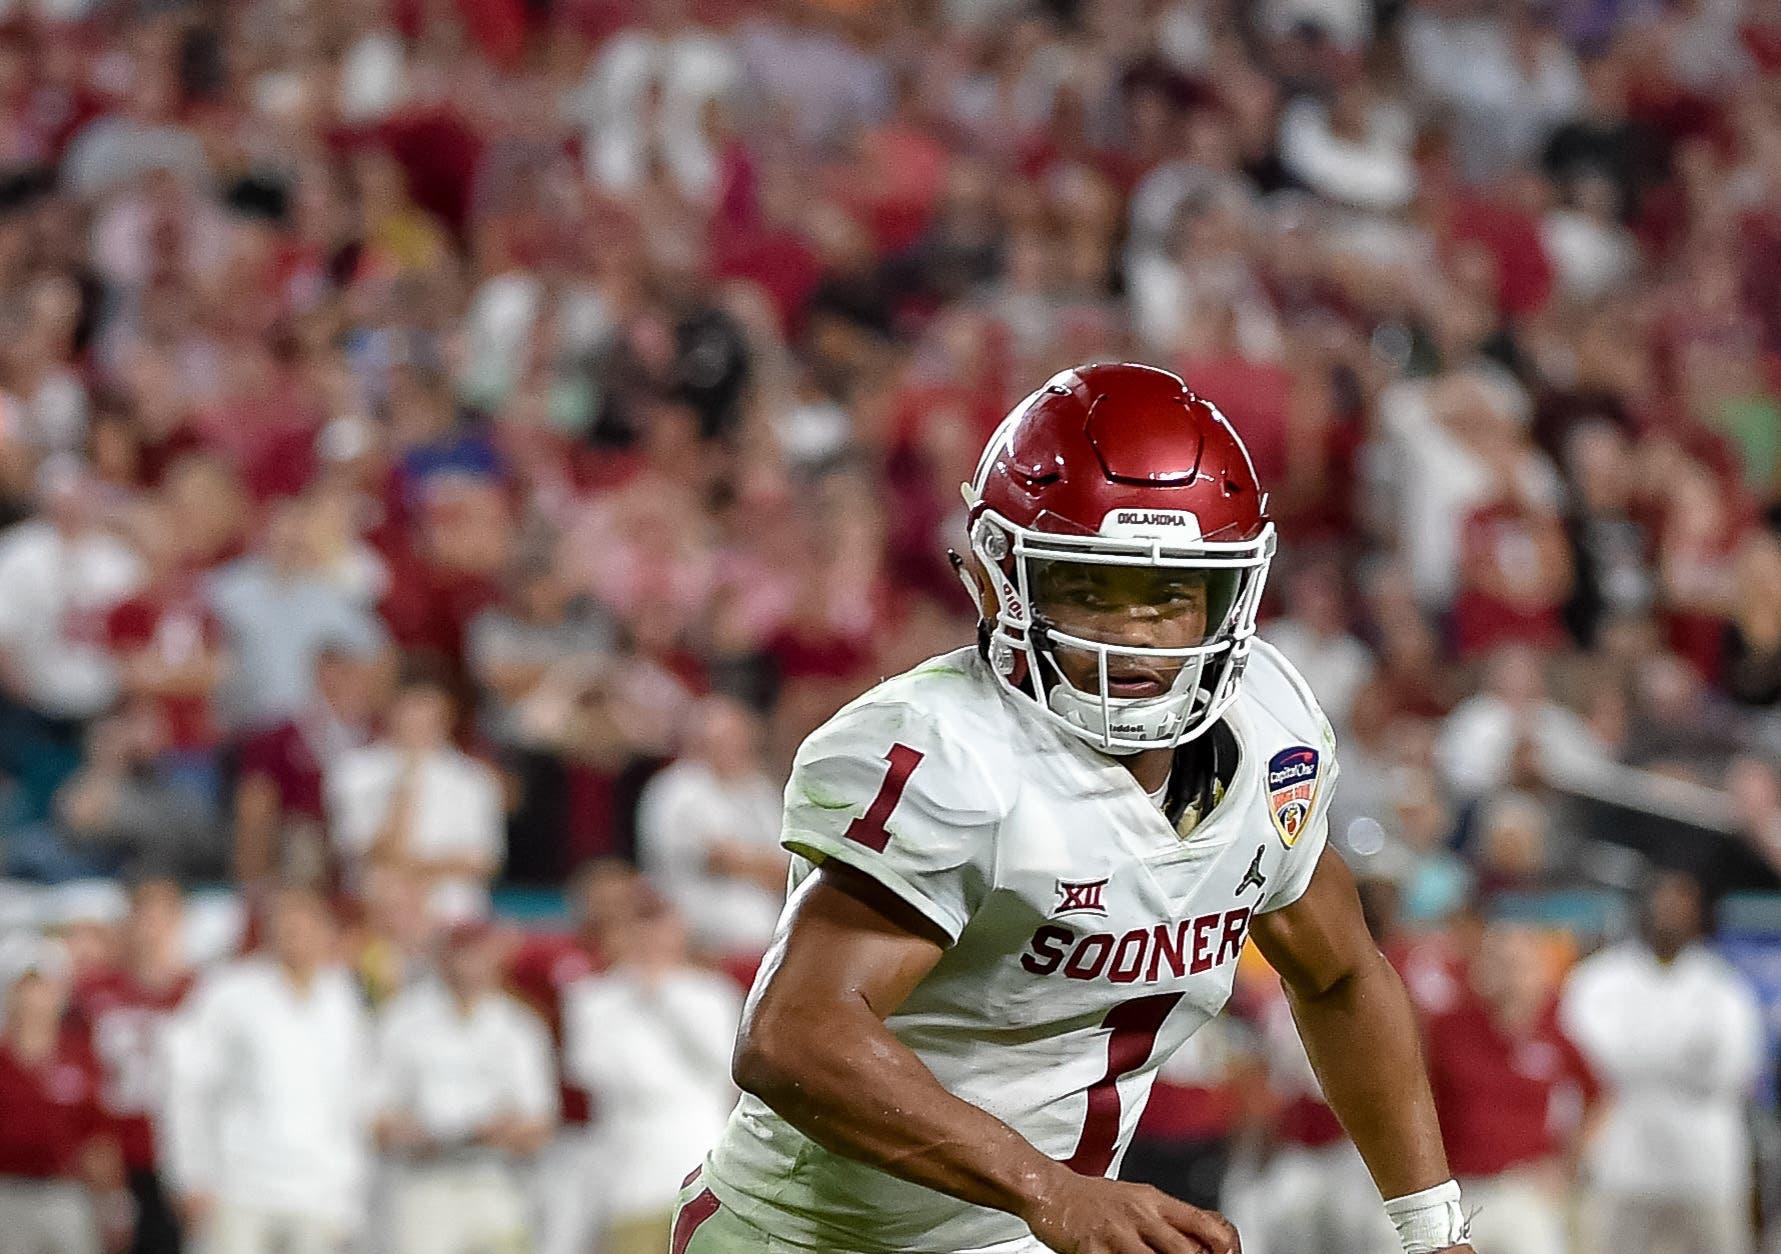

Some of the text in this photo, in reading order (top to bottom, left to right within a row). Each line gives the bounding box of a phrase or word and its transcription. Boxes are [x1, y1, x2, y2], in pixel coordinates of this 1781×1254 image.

[1117, 512, 1186, 526] OKLAHOMA
[843, 743, 925, 854] 1
[1054, 878, 1110, 914] XII
[1061, 990, 1186, 1178] 1
